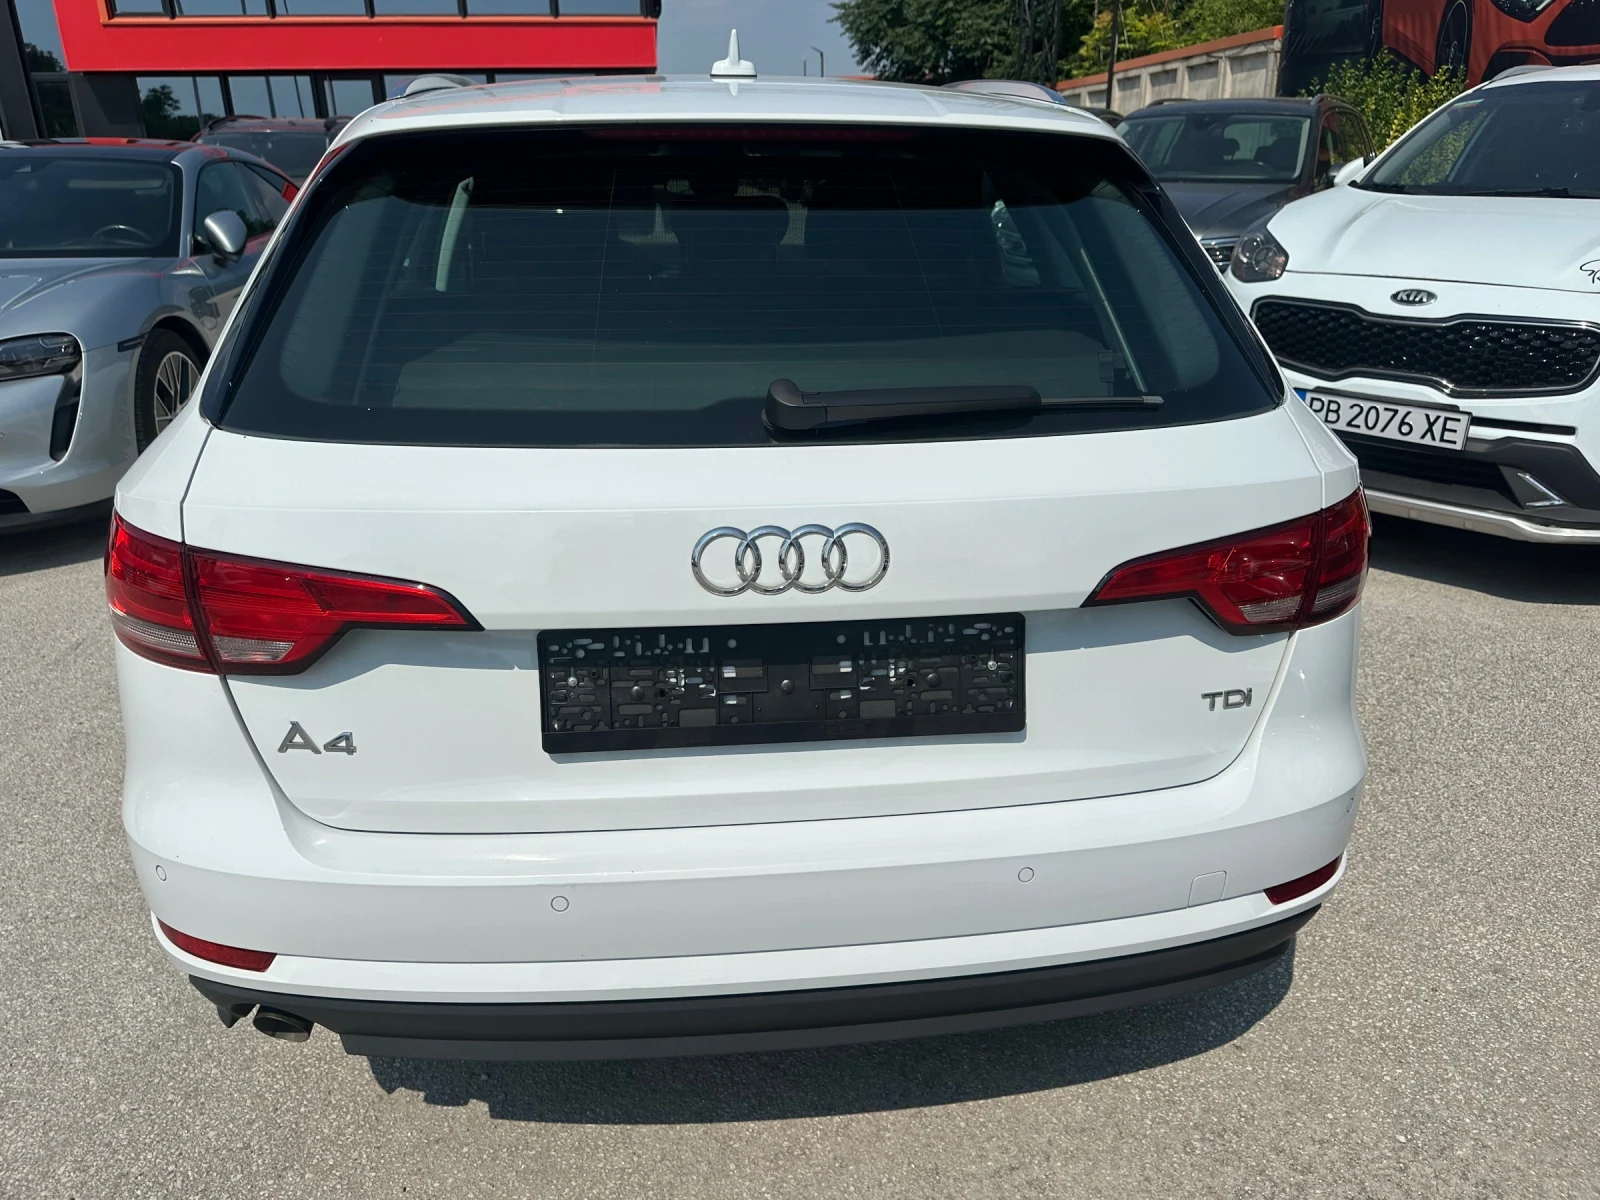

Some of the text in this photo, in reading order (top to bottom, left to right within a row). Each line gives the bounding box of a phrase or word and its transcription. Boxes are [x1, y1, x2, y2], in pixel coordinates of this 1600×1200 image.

[1397, 290, 1428, 302] KIA
[1309, 397, 1461, 445] PB 2076 XE
[277, 721, 357, 755] A4
